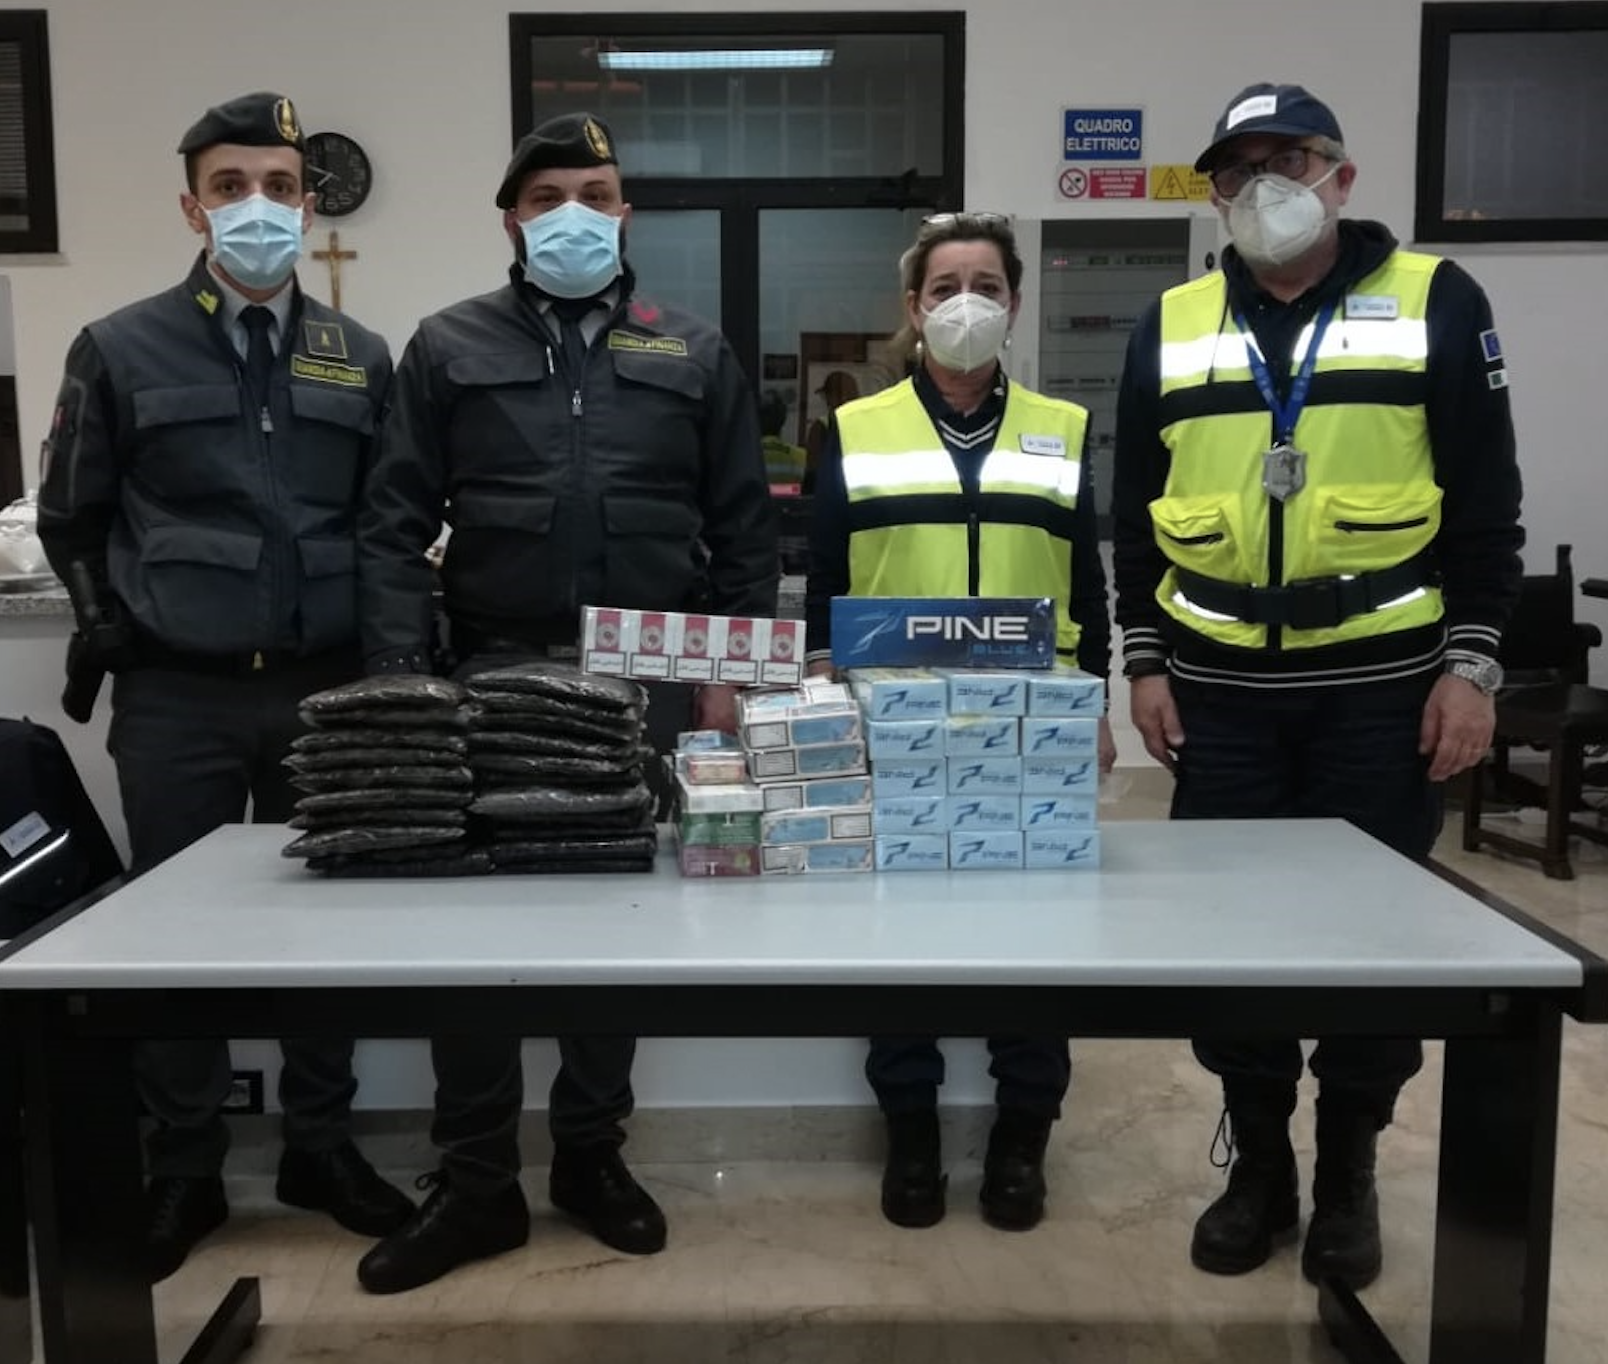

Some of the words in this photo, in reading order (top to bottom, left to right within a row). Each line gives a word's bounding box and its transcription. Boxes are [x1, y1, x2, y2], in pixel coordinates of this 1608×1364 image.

[1074, 119, 1133, 133] QUADRO
[1066, 137, 1140, 151] ELETTRICO
[905, 616, 1029, 641] PINE
[972, 644, 1028, 655] BLUE
